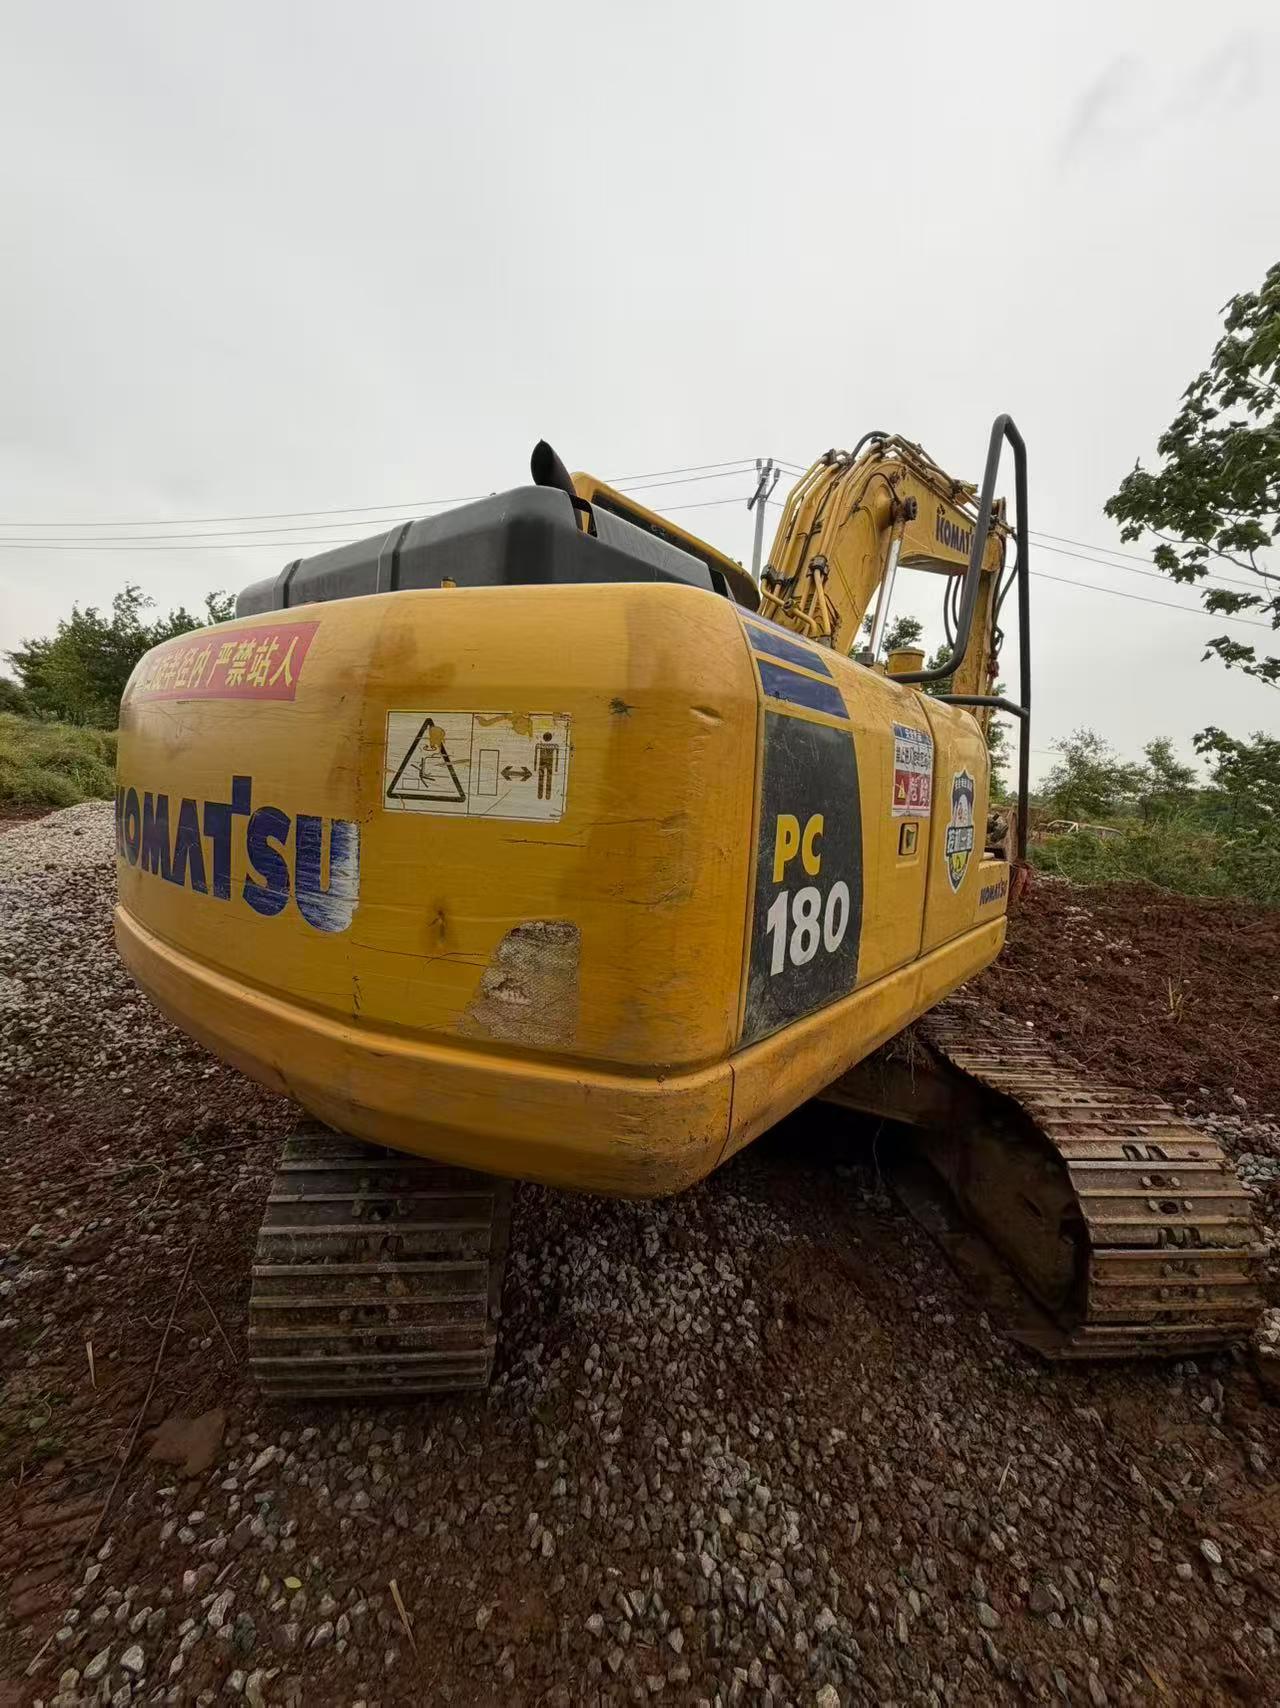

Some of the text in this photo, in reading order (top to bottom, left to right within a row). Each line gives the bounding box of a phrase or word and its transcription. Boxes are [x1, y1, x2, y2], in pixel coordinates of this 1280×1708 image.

[207, 635, 299, 688] 严禁站人
[772, 813, 824, 883] PC
[766, 880, 850, 977] 180
